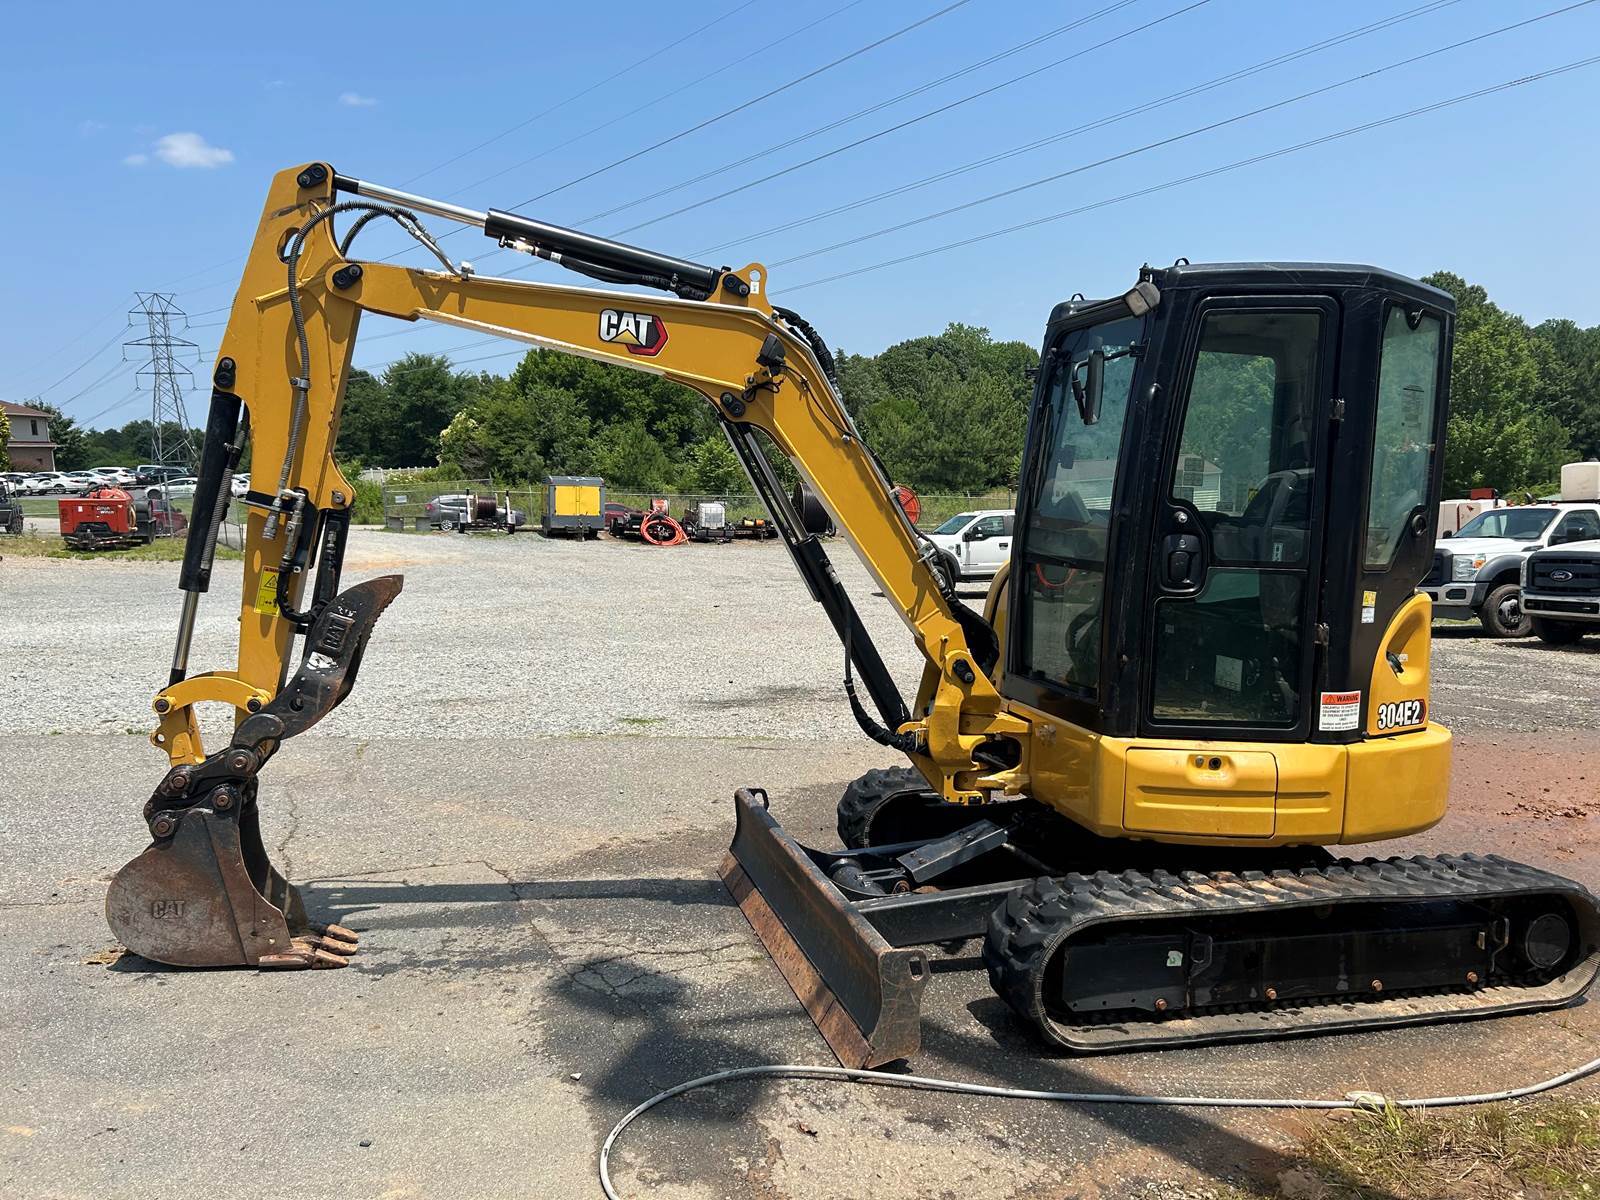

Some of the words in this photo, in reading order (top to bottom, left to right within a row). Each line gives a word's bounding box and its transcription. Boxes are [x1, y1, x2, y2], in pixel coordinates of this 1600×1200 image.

[600, 309, 653, 346] CAT
[1336, 694, 1359, 703] WARNING
[1378, 700, 1421, 729] 304E2
[151, 900, 185, 919] CAT
